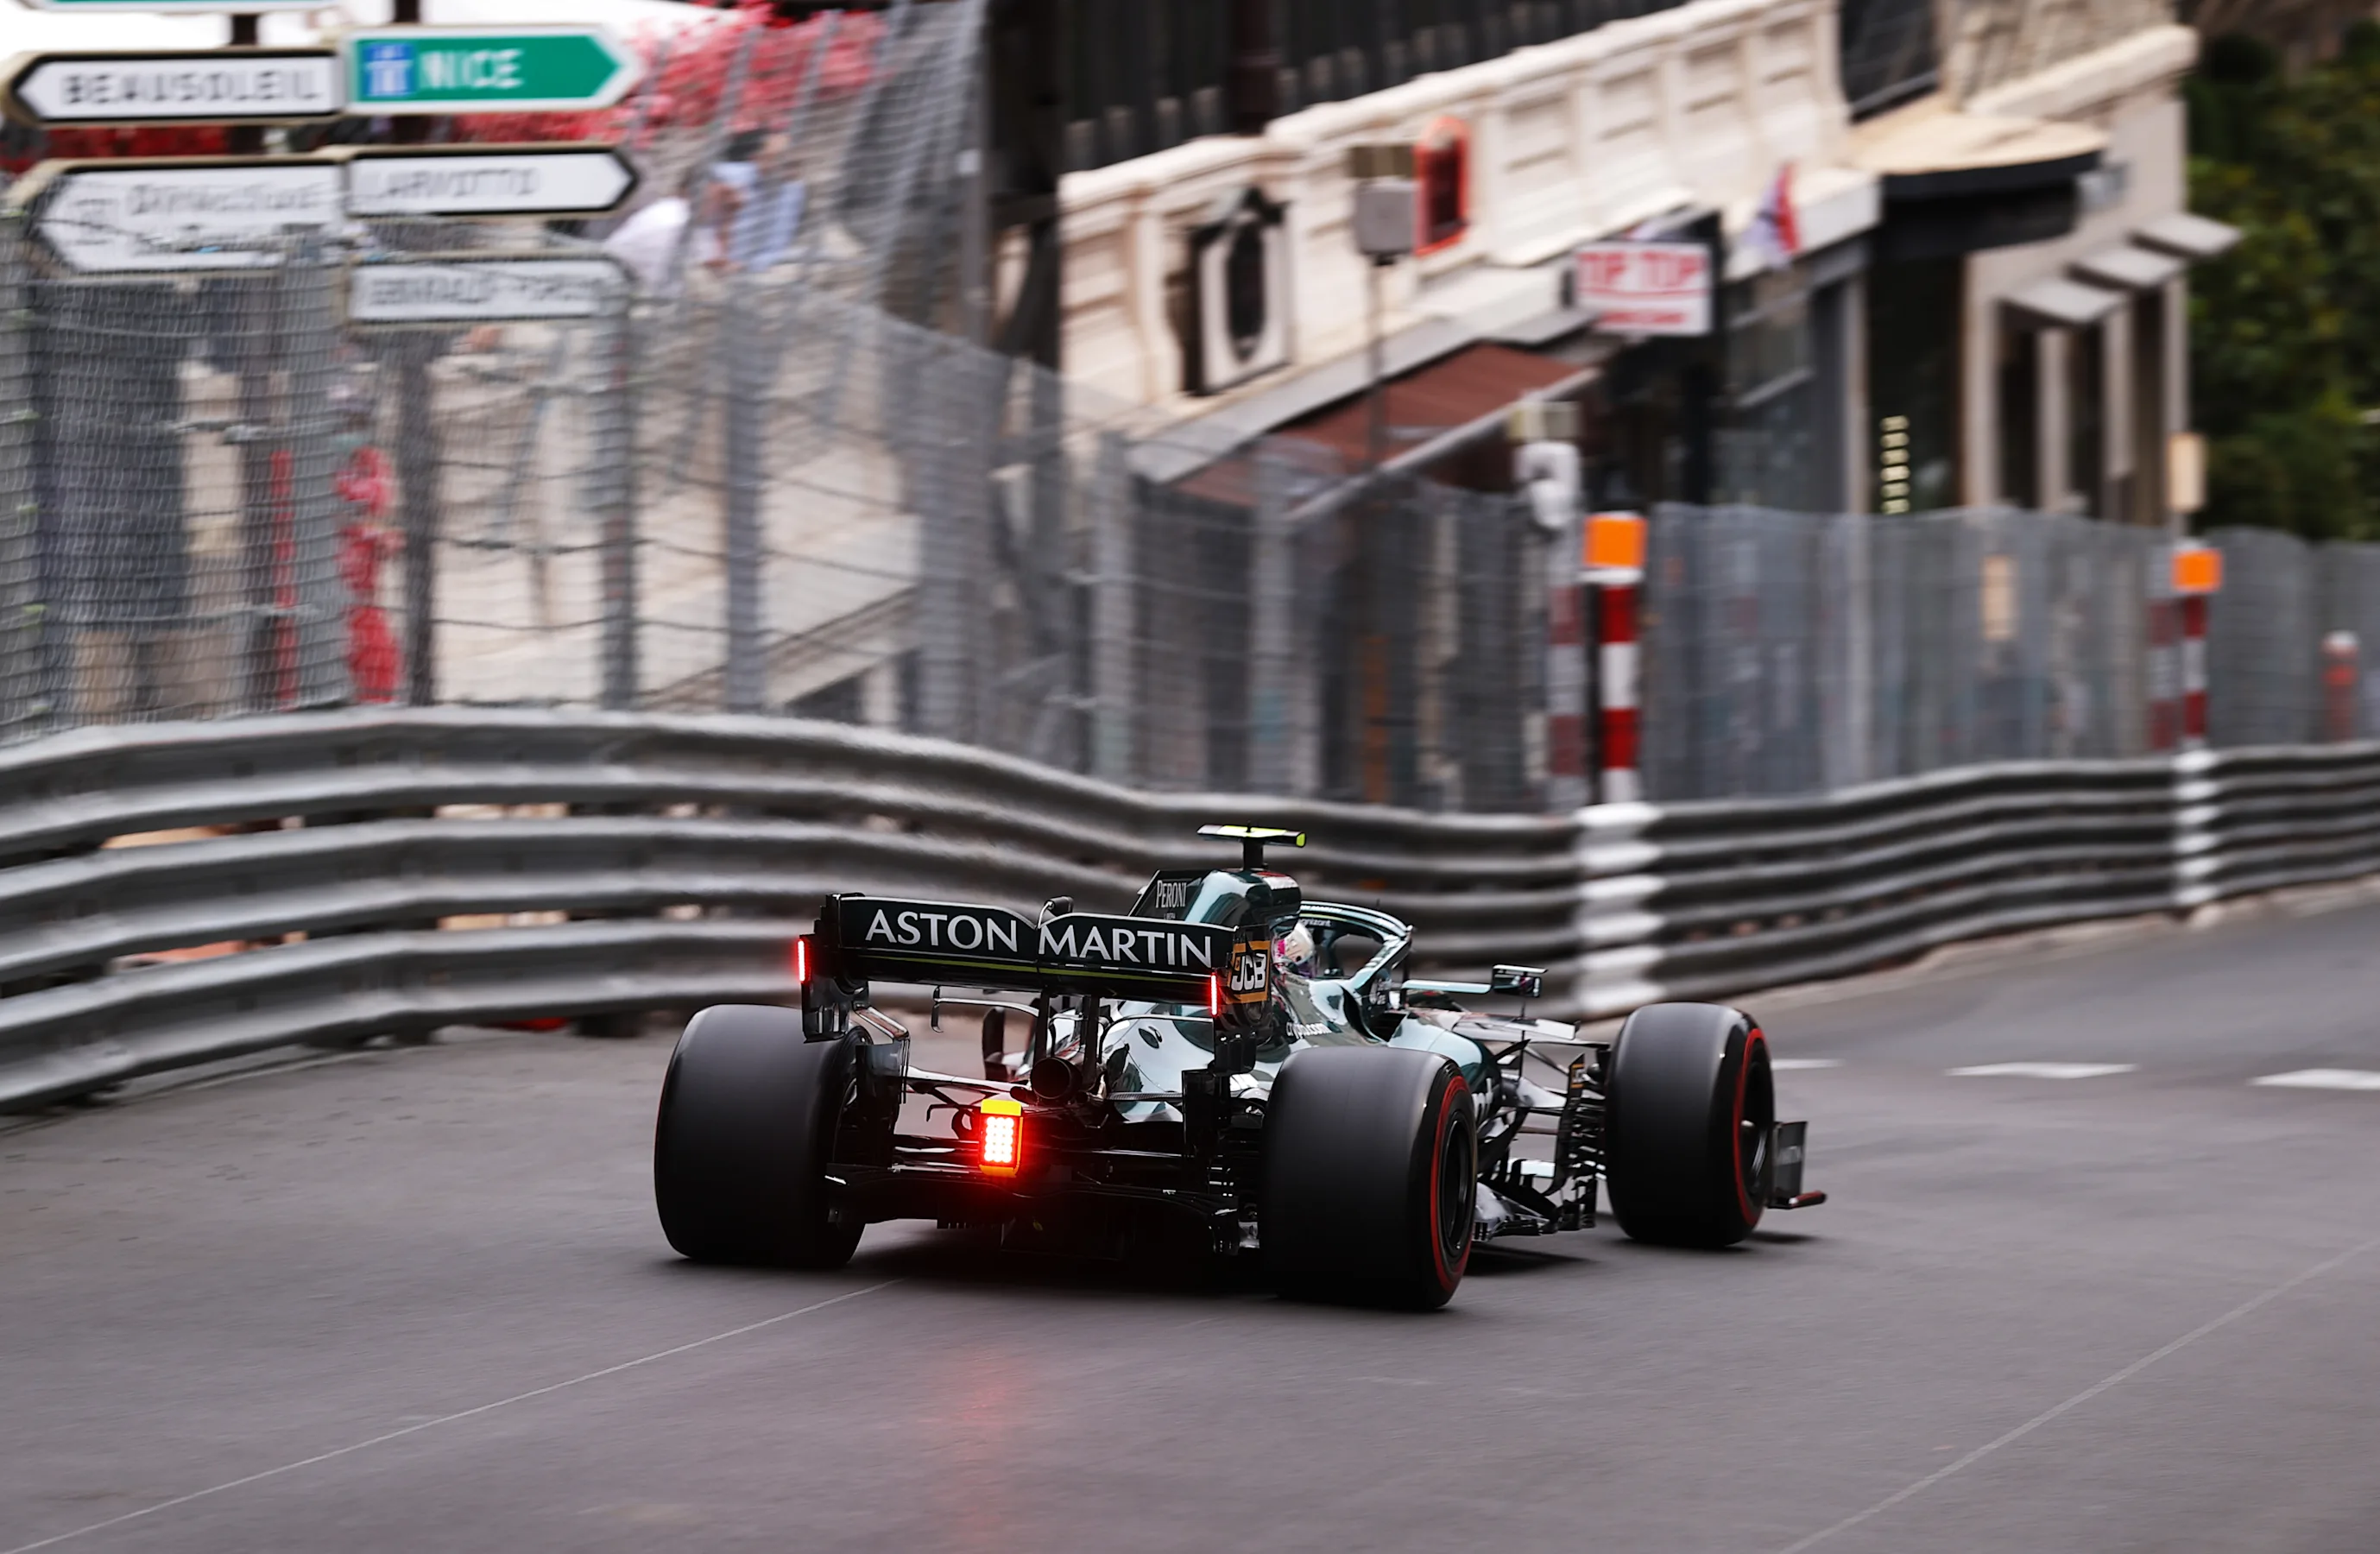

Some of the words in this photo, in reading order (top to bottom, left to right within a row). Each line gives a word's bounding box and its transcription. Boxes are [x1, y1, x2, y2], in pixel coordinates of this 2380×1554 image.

[420, 47, 523, 90] NICE
[61, 70, 320, 107] BEAUSOLEIL
[1155, 880, 1187, 908] PERONI
[865, 908, 1019, 952] ASTON
[1038, 925, 1212, 968] MARTIN
[1231, 952, 1267, 991] JCB
